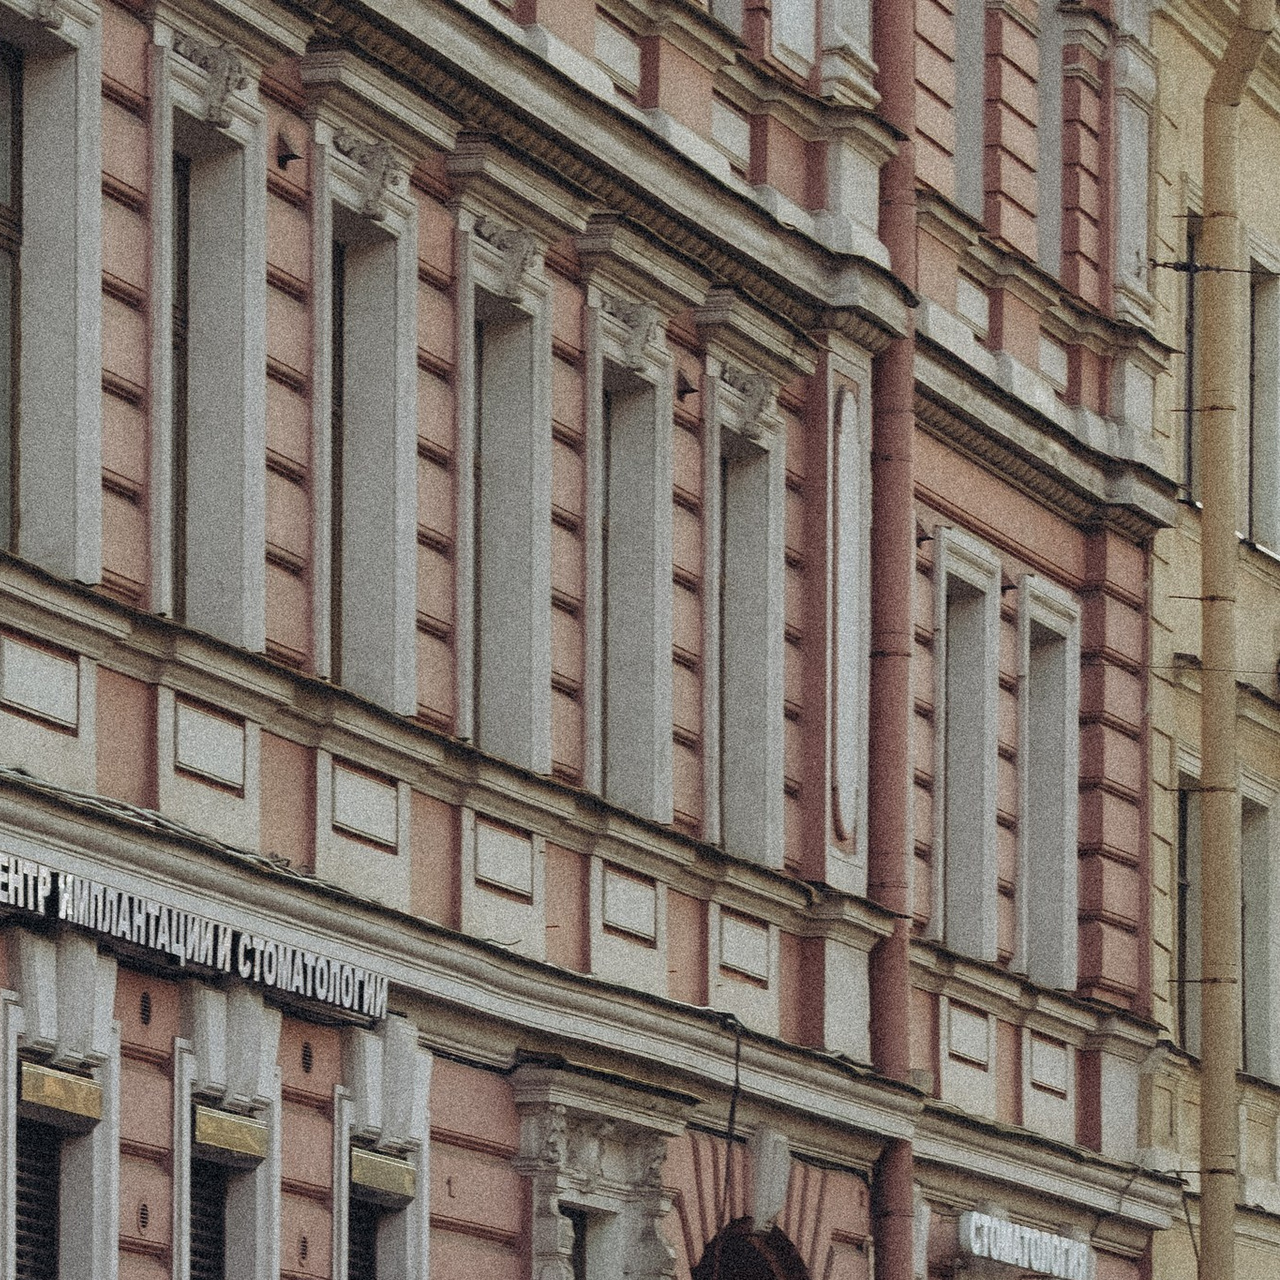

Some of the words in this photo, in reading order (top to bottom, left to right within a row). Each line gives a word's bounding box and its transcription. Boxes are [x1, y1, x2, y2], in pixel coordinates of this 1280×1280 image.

[58, 872, 215, 967] ИМПЛАНТАЦИИ
[216, 924, 232, 972] И
[238, 932, 388, 1019] СТОМАТОЛОГИИ
